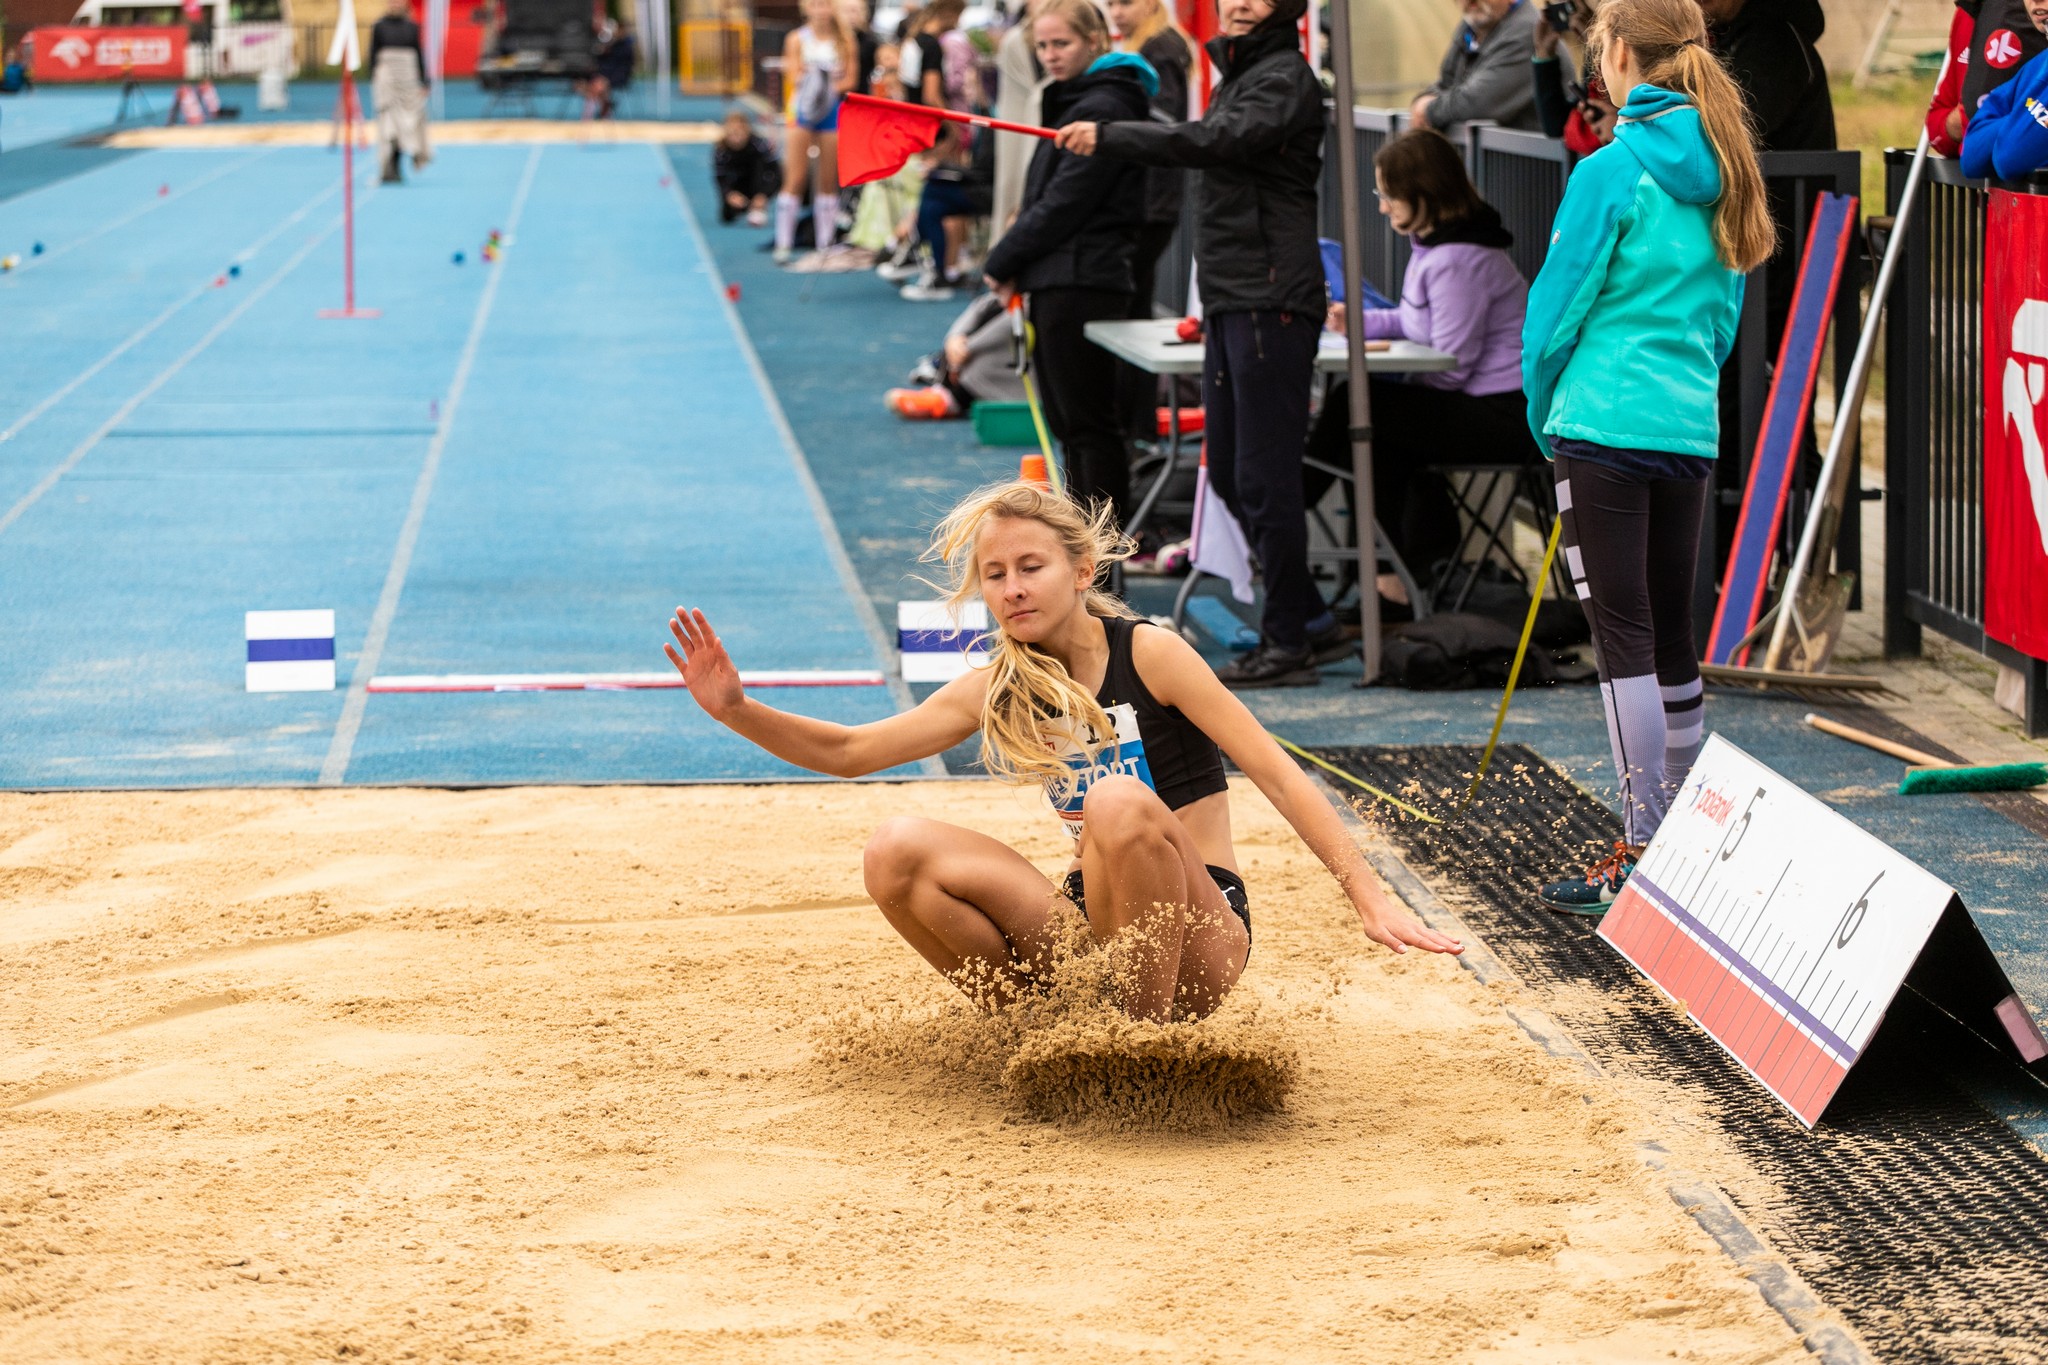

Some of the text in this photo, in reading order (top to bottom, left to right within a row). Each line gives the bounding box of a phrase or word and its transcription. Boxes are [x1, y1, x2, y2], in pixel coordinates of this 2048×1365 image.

[1691, 786, 1737, 827] polanik
[1721, 787, 1767, 862] 5
[1837, 869, 1886, 949] 6
